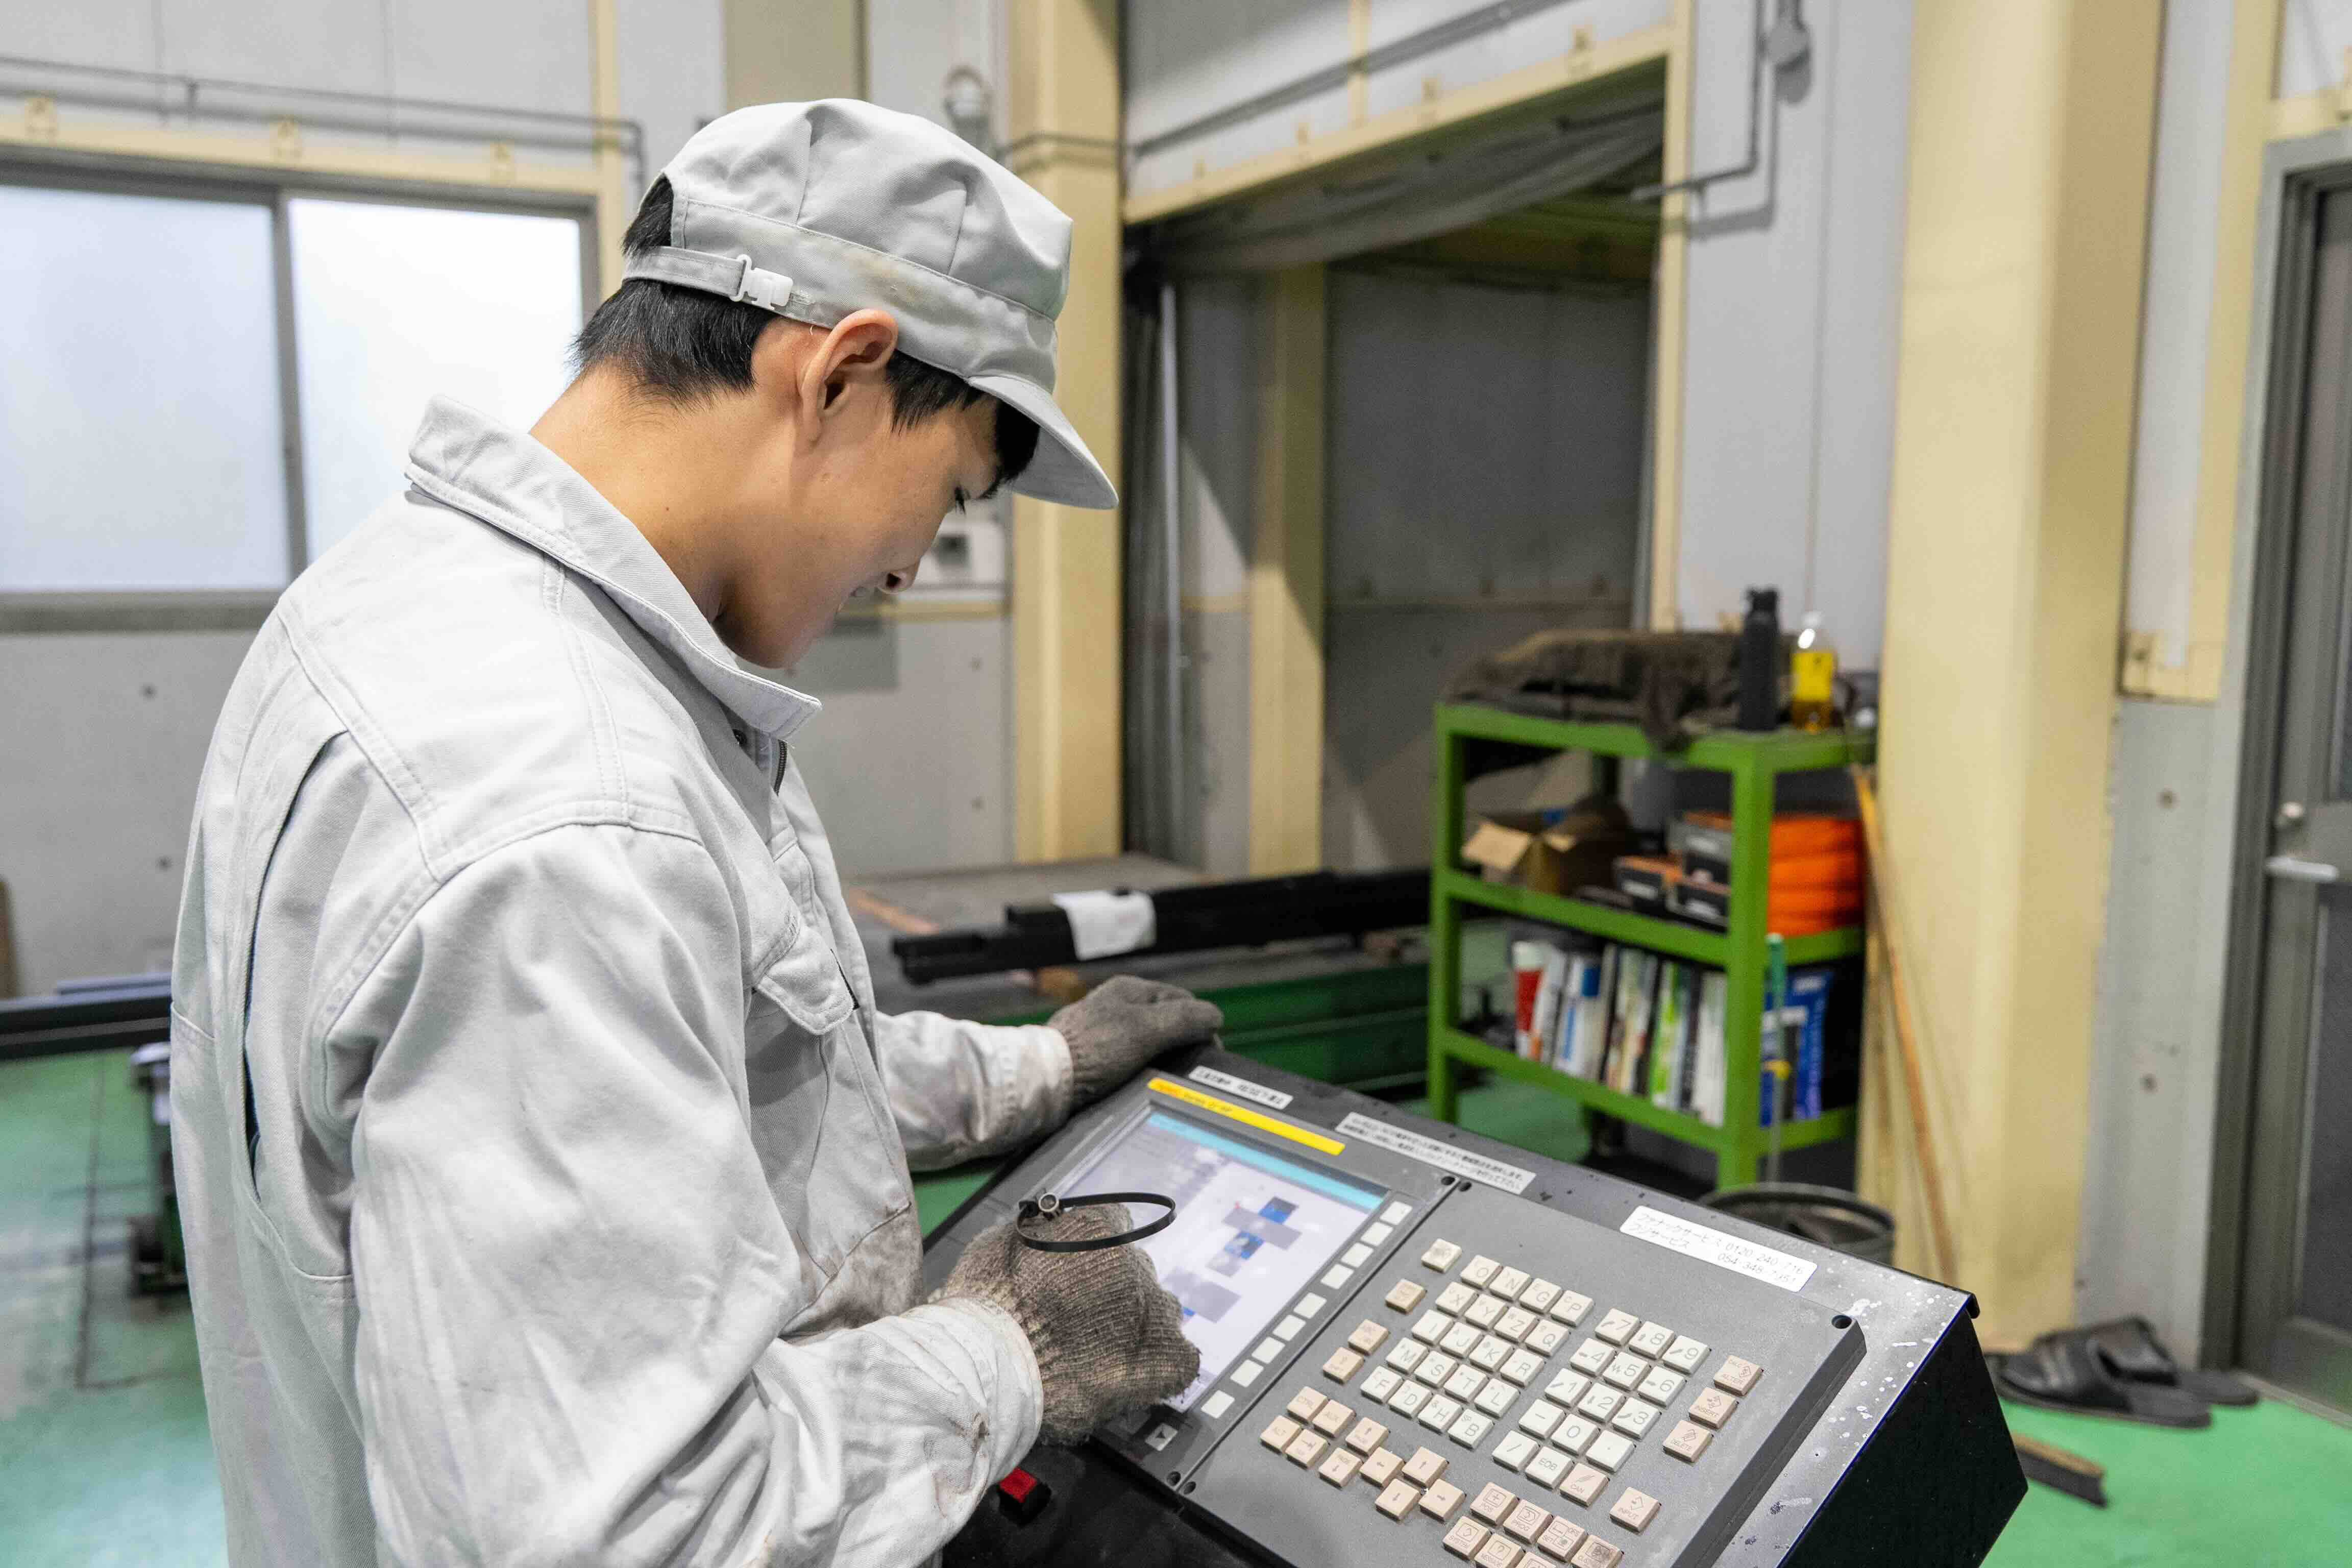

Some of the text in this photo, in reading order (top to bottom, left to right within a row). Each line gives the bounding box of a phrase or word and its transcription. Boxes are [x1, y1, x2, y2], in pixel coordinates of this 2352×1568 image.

[1505, 1278, 1520, 1290] N
[1451, 1294, 1464, 1306] X
[1536, 1291, 1550, 1303] G
[1482, 1306, 1495, 1317] Y
[1567, 1303, 1581, 1312] P
[1510, 1320, 1525, 1332] Z
[1619, 1319, 1632, 1333] 7
[1456, 1338, 1471, 1348] J
[1544, 1334, 1555, 1346] Q
[1650, 1332, 1666, 1346] 8
[1401, 1350, 1416, 1363] M
[1484, 1349, 1501, 1361] K
[1592, 1352, 1606, 1365] 4
[1684, 1347, 1699, 1360] 9
[1431, 1364, 1445, 1377] S
[1515, 1362, 1531, 1377] R
[1624, 1364, 1640, 1377] 5
[1375, 1379, 1390, 1389] F
[1463, 1377, 1475, 1390] T
[1722, 1373, 1745, 1385] ALTER
[1567, 1382, 1578, 1393] 1
[1659, 1380, 1675, 1392] 6
[1404, 1393, 1417, 1406] D
[1490, 1392, 1500, 1406] L
[1597, 1396, 1614, 1410] 2
[1433, 1408, 1450, 1422] H
[1633, 1411, 1649, 1425] 3
[1694, 1405, 1720, 1418] INSERT
[1465, 1424, 1479, 1437] B
[1670, 1438, 1693, 1452] DELETE
[1538, 1458, 1558, 1471] EOB
[1569, 1484, 1585, 1493] CAN
[1618, 1507, 1639, 1521] INPUT
[1511, 1517, 1531, 1532] PROG
